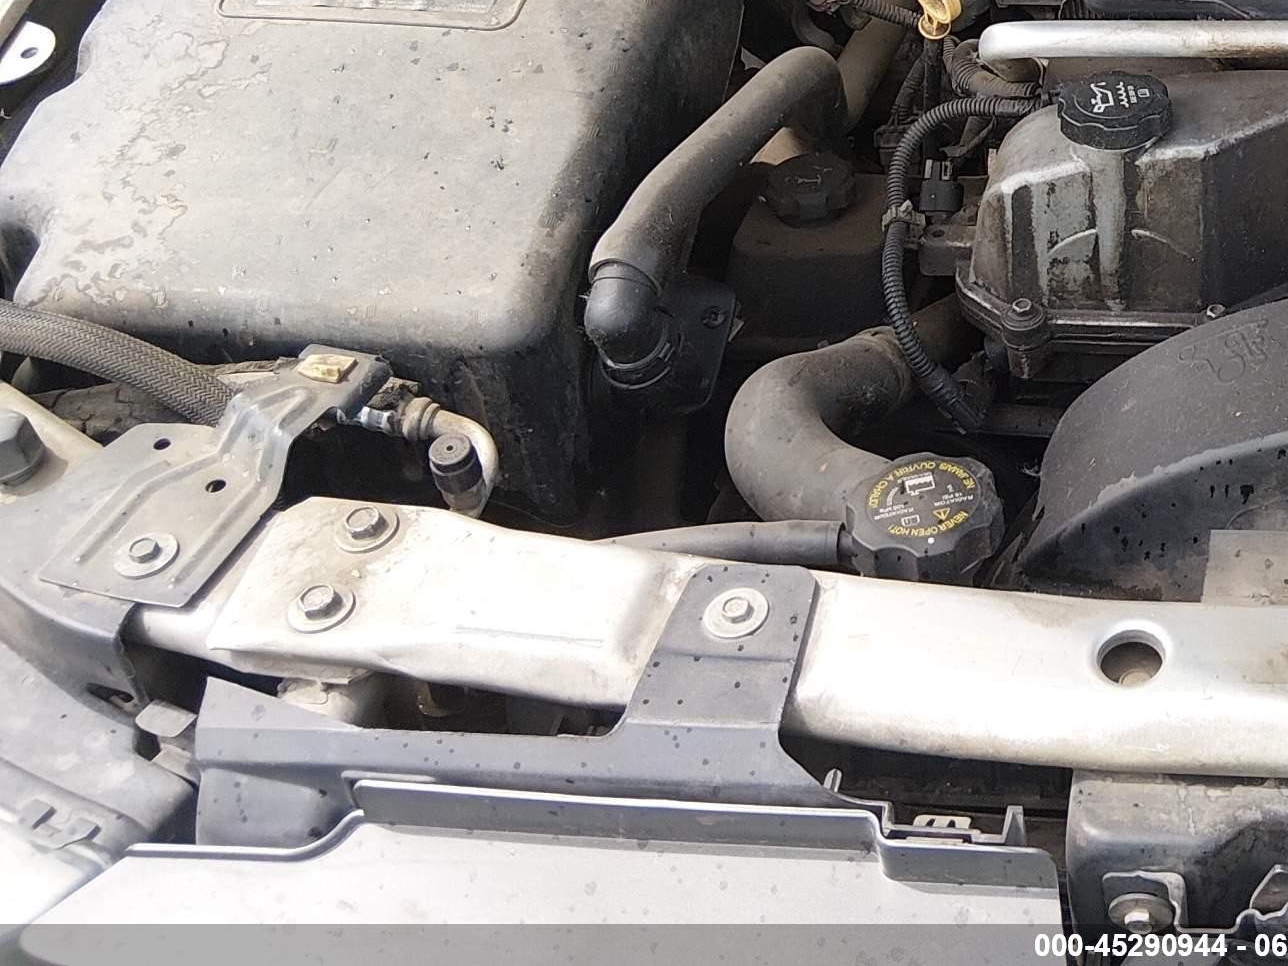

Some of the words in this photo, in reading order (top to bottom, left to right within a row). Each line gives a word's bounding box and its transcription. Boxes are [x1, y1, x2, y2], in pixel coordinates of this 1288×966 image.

[938, 462, 970, 480] JAMAIS
[962, 477, 976, 490] NE
[933, 494, 974, 506] RADIATOR
[873, 507, 914, 520] RADIATEUR
[937, 510, 969, 531] NEVER
[910, 525, 938, 536] OPEN
